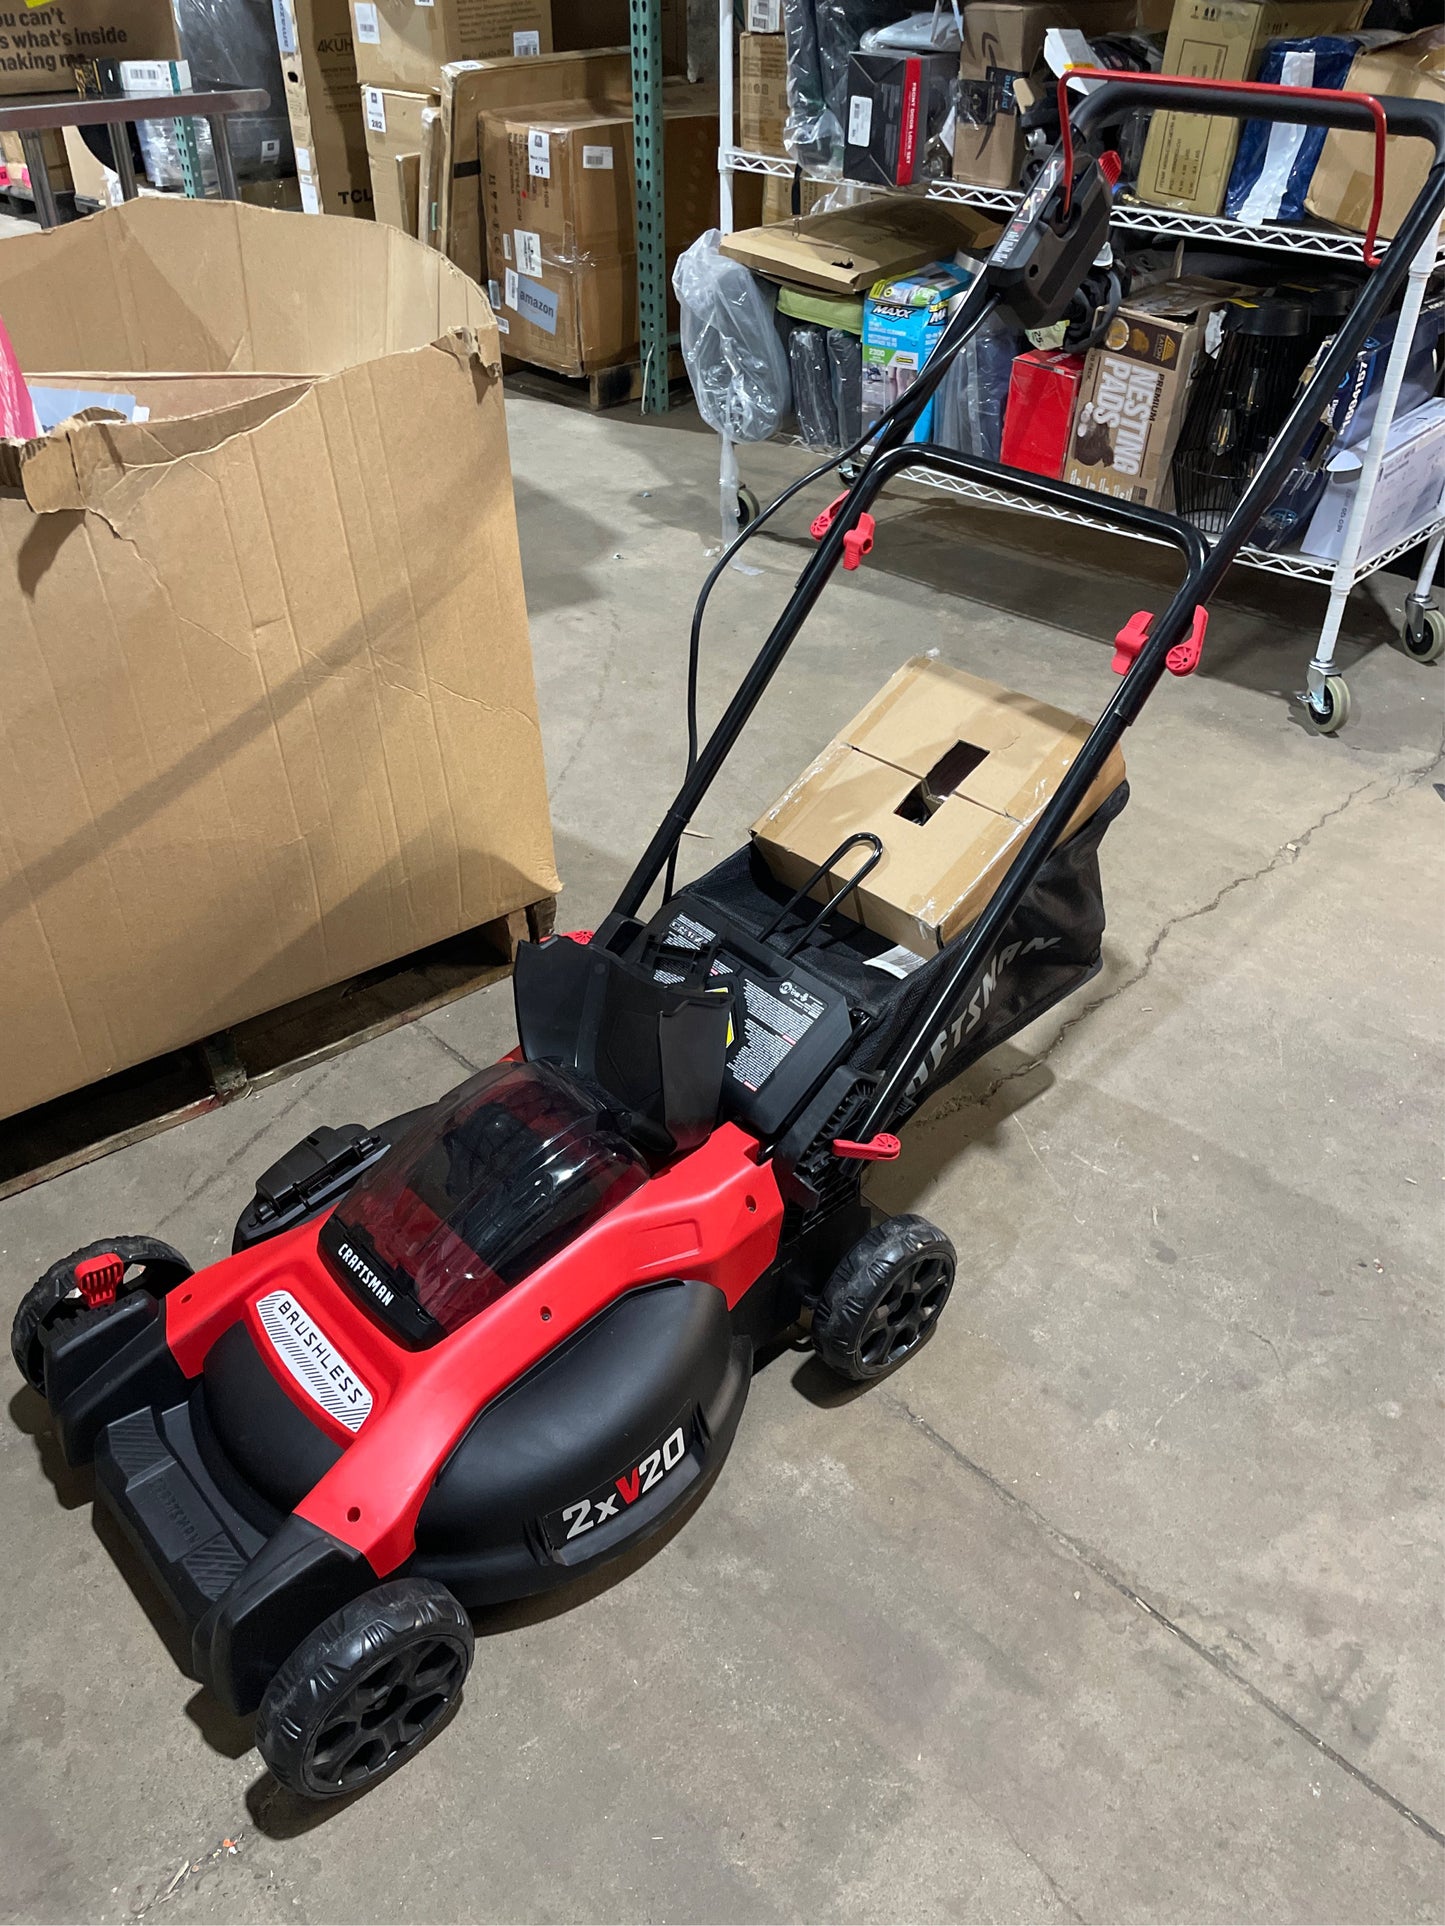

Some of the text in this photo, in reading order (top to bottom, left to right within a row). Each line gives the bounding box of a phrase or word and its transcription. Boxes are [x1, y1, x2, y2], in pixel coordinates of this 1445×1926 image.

[20, 8, 66, 26] can't
[11, 29, 73, 48] what's
[74, 26, 127, 45] inside
[318, 38, 353, 52] 4KUH
[534, 164, 544, 175] 51
[338, 189, 373, 205] TCL
[520, 290, 554, 318] amazon
[872, 304, 913, 319] MAXX
[1092, 357, 1132, 429] PADS
[1149, 373, 1165, 422] PREMIUM
[1113, 365, 1160, 476] NESTING
[338, 1243, 395, 1307] CRAFTSMAN
[278, 1300, 363, 1404] BRUSHLESS
[562, 1427, 685, 1540] 2xV20
